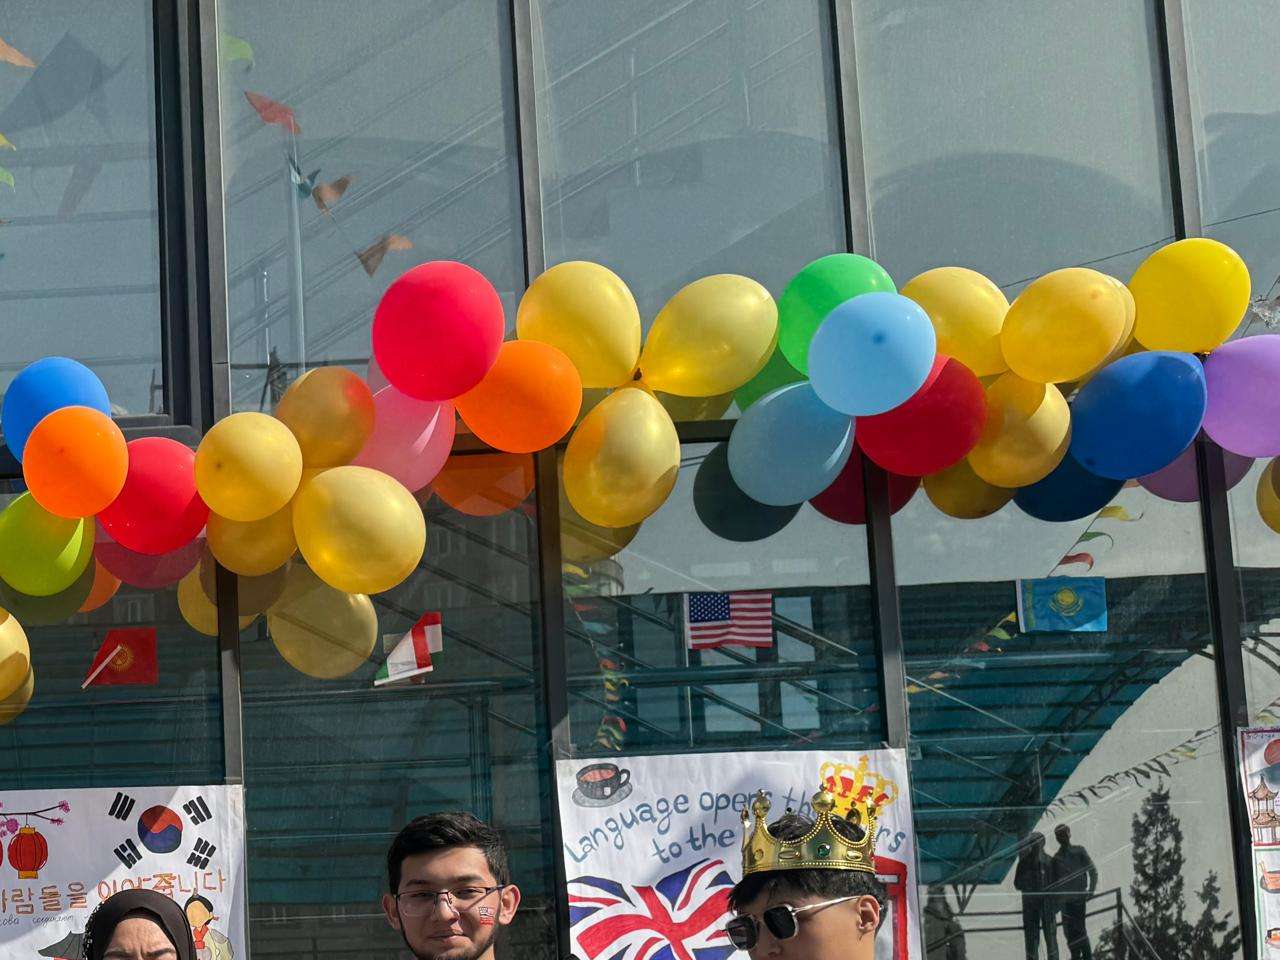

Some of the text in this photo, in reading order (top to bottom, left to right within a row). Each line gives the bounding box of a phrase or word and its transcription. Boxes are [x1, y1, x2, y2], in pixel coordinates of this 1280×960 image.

[565, 793, 689, 863] Language
[782, 786, 813, 818] th
[651, 822, 735, 864] to the
